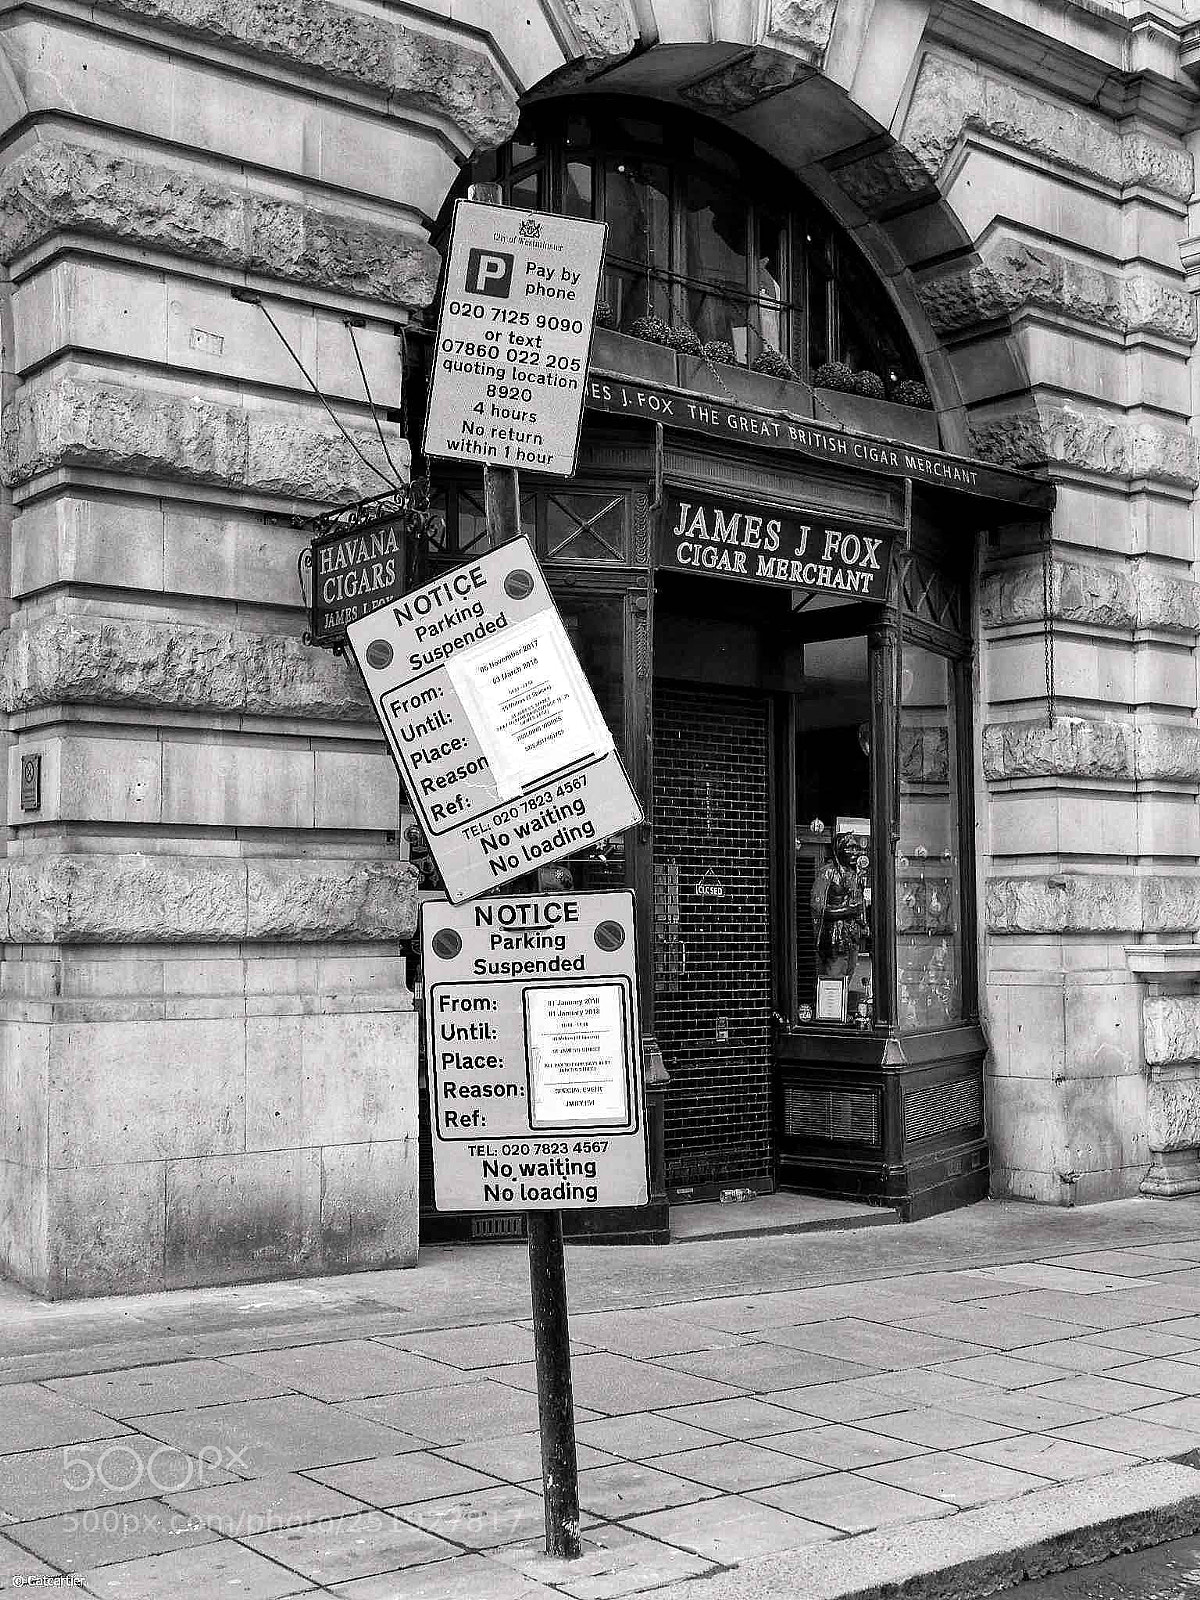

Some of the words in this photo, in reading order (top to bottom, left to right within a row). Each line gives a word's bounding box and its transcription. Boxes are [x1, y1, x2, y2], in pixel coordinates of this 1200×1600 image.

[477, 255, 506, 290] P
[526, 262, 555, 281] Pay
[561, 267, 581, 285] by
[525, 282, 575, 300] phone
[449, 301, 484, 318] 020
[491, 308, 529, 325] 7125
[536, 315, 582, 334] 9090
[485, 331, 502, 342] or
[508, 331, 542, 348] text
[442, 339, 499, 359] 07860
[507, 349, 539, 365] 022
[546, 355, 580, 371] 205
[443, 359, 505, 380] quoting
[512, 366, 577, 389] location
[487, 384, 532, 402] 8920
[473, 402, 484, 415] 4
[491, 403, 537, 423] hours
[461, 420, 484, 436] No
[491, 428, 542, 445] return
[586, 383, 612, 401] ES
[637, 392, 674, 415] FOX
[687, 403, 720, 426] THE
[727, 414, 781, 438] GREAT
[787, 425, 848, 455] BRITISH
[853, 443, 899, 467] CIGAR
[904, 454, 978, 486] MERCHANT
[447, 439, 497, 457] within
[505, 446, 510, 459] 1
[516, 447, 553, 464] hour
[673, 502, 782, 551] JAMES
[794, 525, 811, 557] J
[822, 530, 883, 570] FOX
[319, 526, 400, 575] HAVANA
[676, 541, 748, 574] CIGAR
[756, 555, 875, 593] MERCHANT
[323, 558, 397, 605] CIGARS
[393, 566, 487, 627] NOTICE
[324, 605, 358, 629] JAMES
[415, 601, 484, 643] Parking
[409, 611, 508, 670] Suspended
[390, 688, 443, 718] From:
[400, 710, 452, 742] Until:
[410, 737, 467, 769] Place:
[420, 756, 489, 796] Reason
[430, 794, 471, 822] Ref:
[462, 823, 491, 840] TEL:
[493, 808, 518, 826] 020
[519, 792, 553, 814] 7823
[557, 774, 586, 797] 4567
[480, 834, 510, 855] No
[513, 798, 585, 839] waiting
[489, 855, 519, 876] No
[521, 820, 595, 861] loading
[475, 902, 578, 926] NOTICE
[491, 931, 565, 950] Parking
[473, 955, 585, 977] Suspended
[440, 995, 497, 1012] From:
[557, 999, 583, 1007] January
[557, 1009, 584, 1017] January
[441, 1023, 496, 1041] Until:
[442, 1052, 503, 1070] Place:
[444, 1082, 524, 1099] Reason:
[445, 1109, 486, 1127] Ref:
[468, 1145, 497, 1156] TEL:
[502, 1144, 530, 1156] 020
[533, 1143, 568, 1155] 7823
[573, 1141, 608, 1153] 4567
[483, 1159, 512, 1178] No
[519, 1158, 596, 1178] waiting
[484, 1184, 514, 1201] No
[521, 1182, 597, 1202] loading
